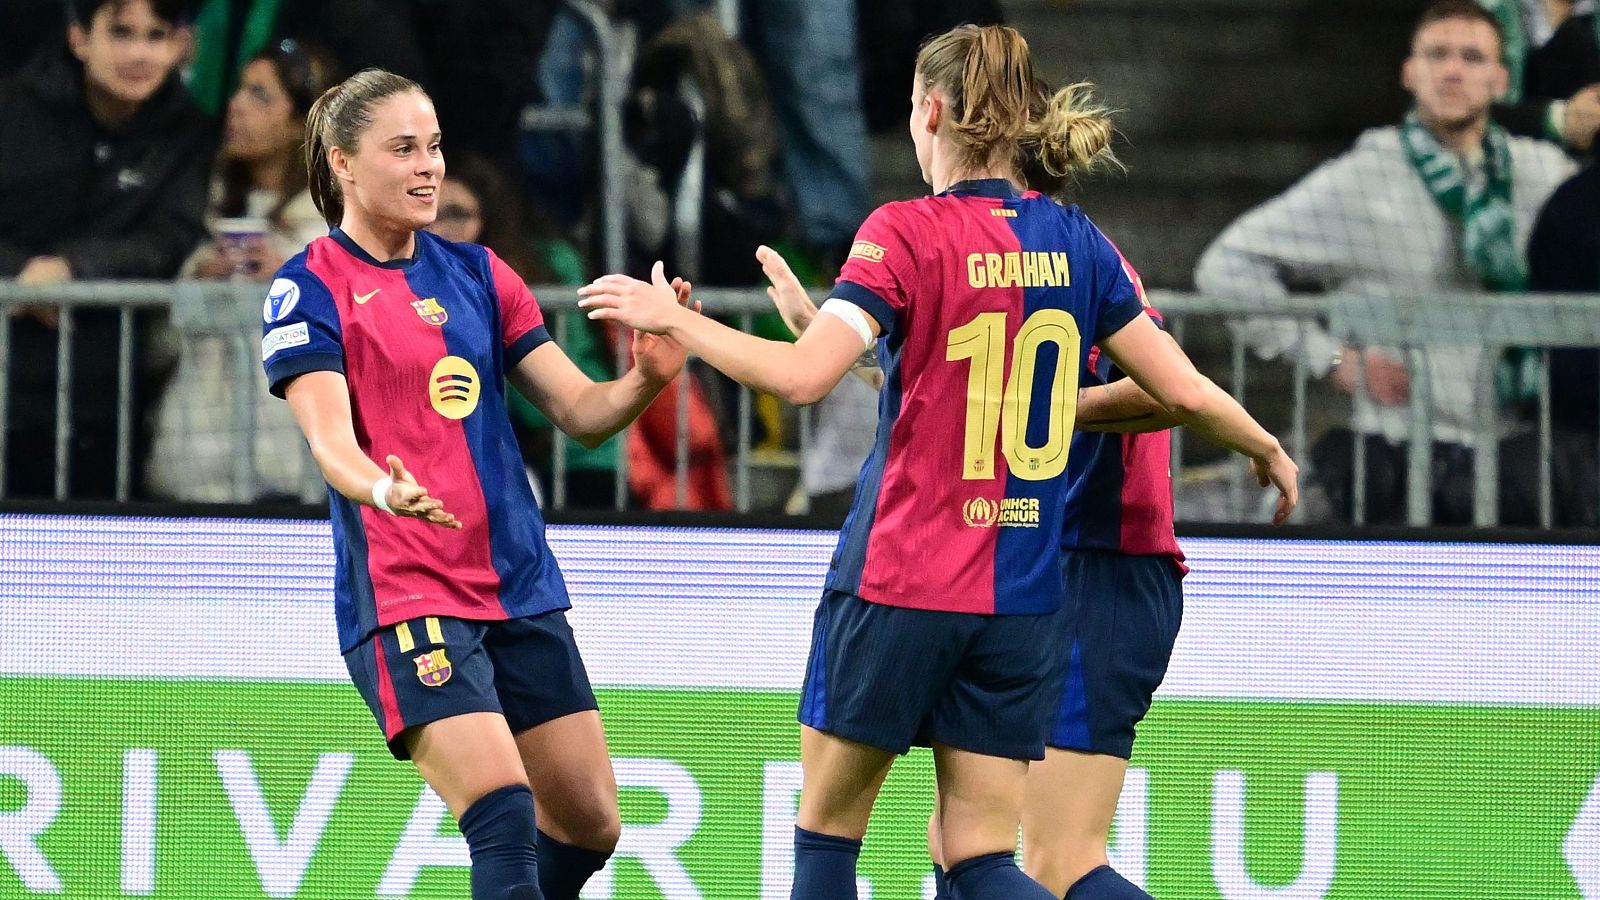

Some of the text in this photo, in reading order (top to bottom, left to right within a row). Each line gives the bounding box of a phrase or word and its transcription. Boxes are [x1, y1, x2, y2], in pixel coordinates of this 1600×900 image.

[850, 243, 885, 260] MBO
[966, 251, 1071, 289] GRAHAM
[945, 308, 1081, 481] 10
[1000, 498, 1040, 511] UNHCR
[997, 510, 1040, 522] ACNUR
